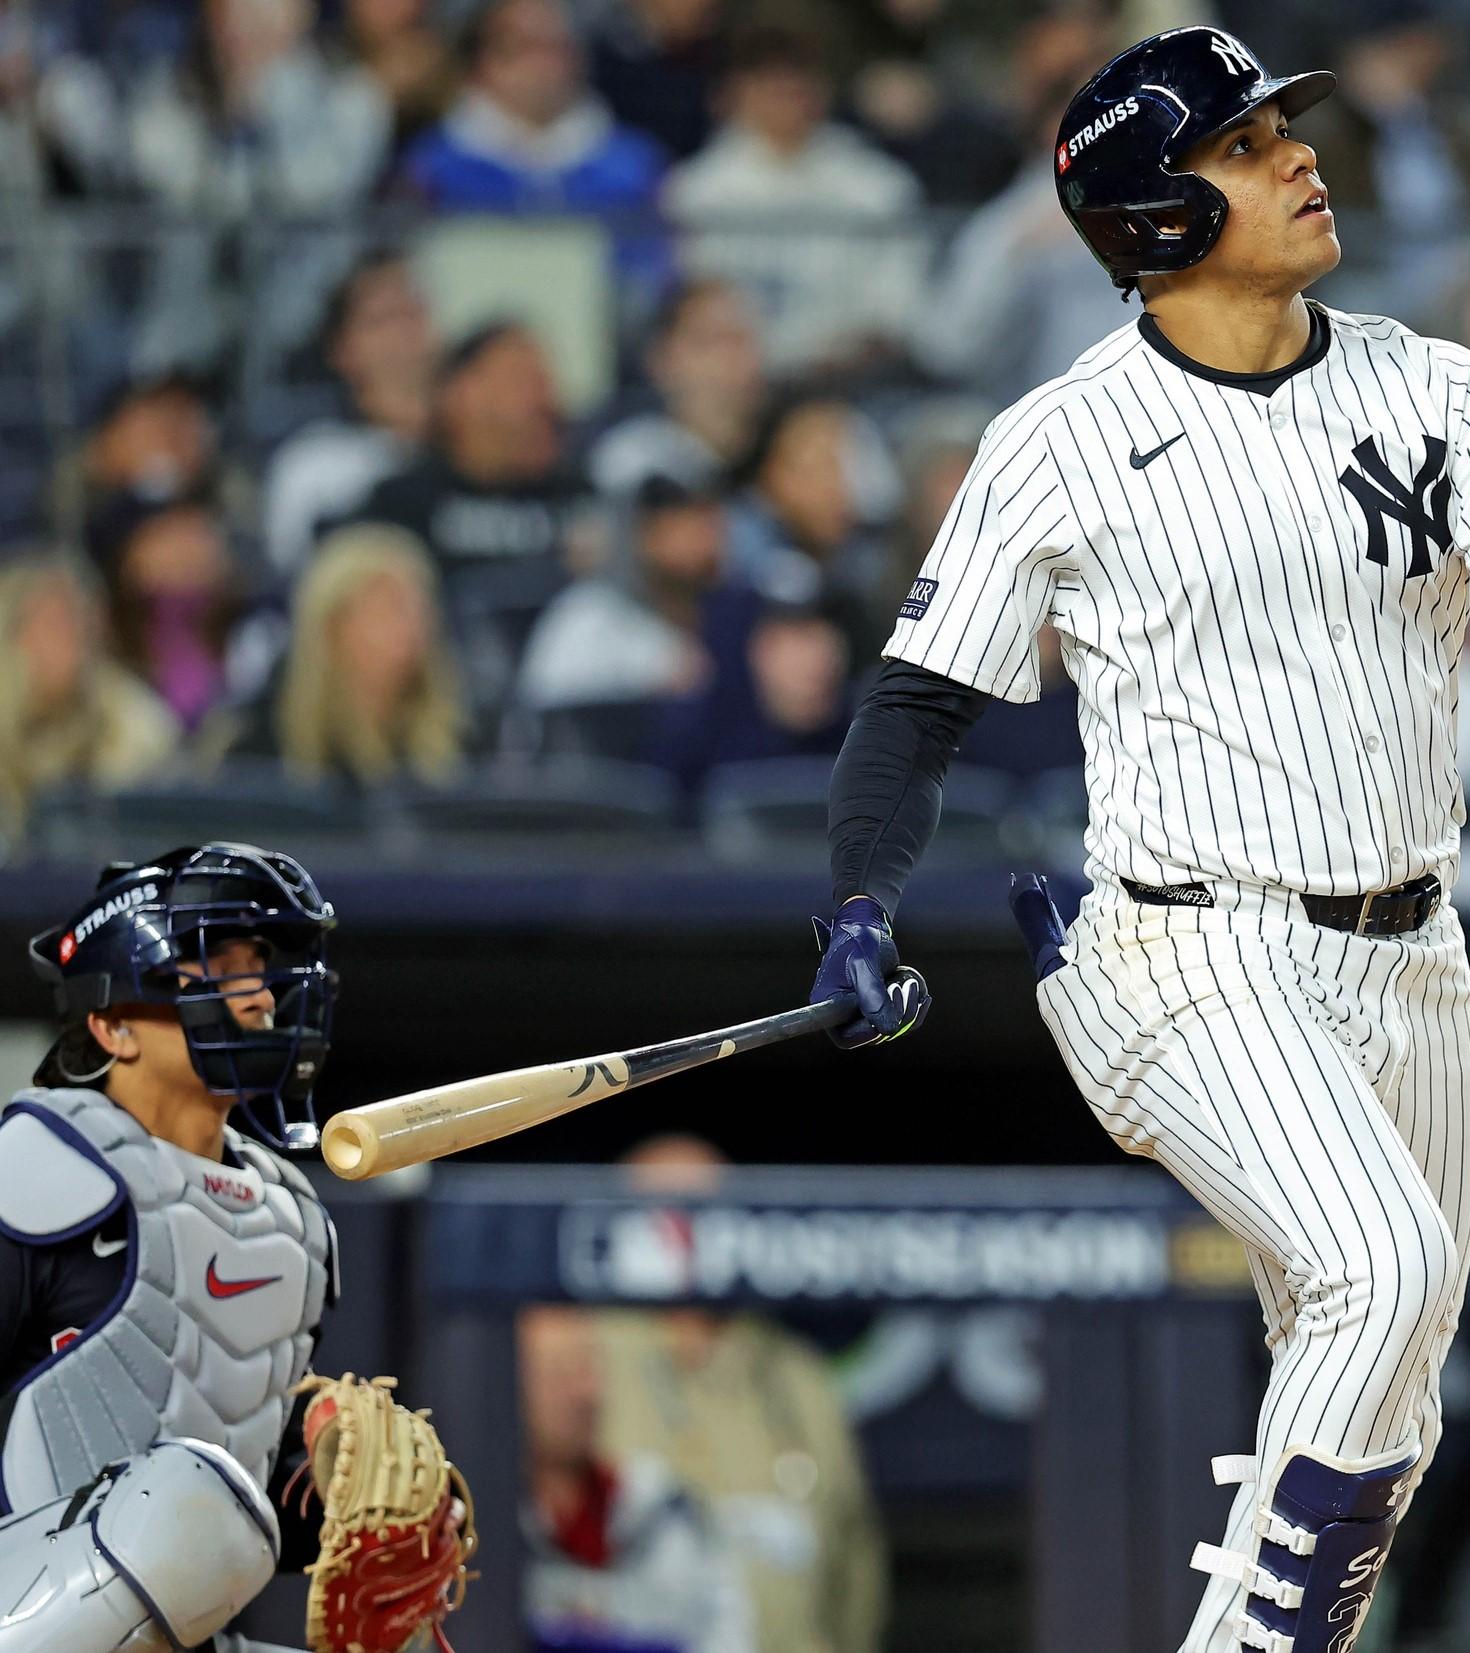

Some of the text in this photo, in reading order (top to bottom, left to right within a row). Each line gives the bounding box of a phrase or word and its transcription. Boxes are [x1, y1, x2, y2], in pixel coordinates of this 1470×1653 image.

[1211, 35, 1258, 76] NY
[1068, 97, 1140, 158] STRAUSS
[1338, 434, 1454, 580] NY
[75, 883, 159, 944] STRAUSS
